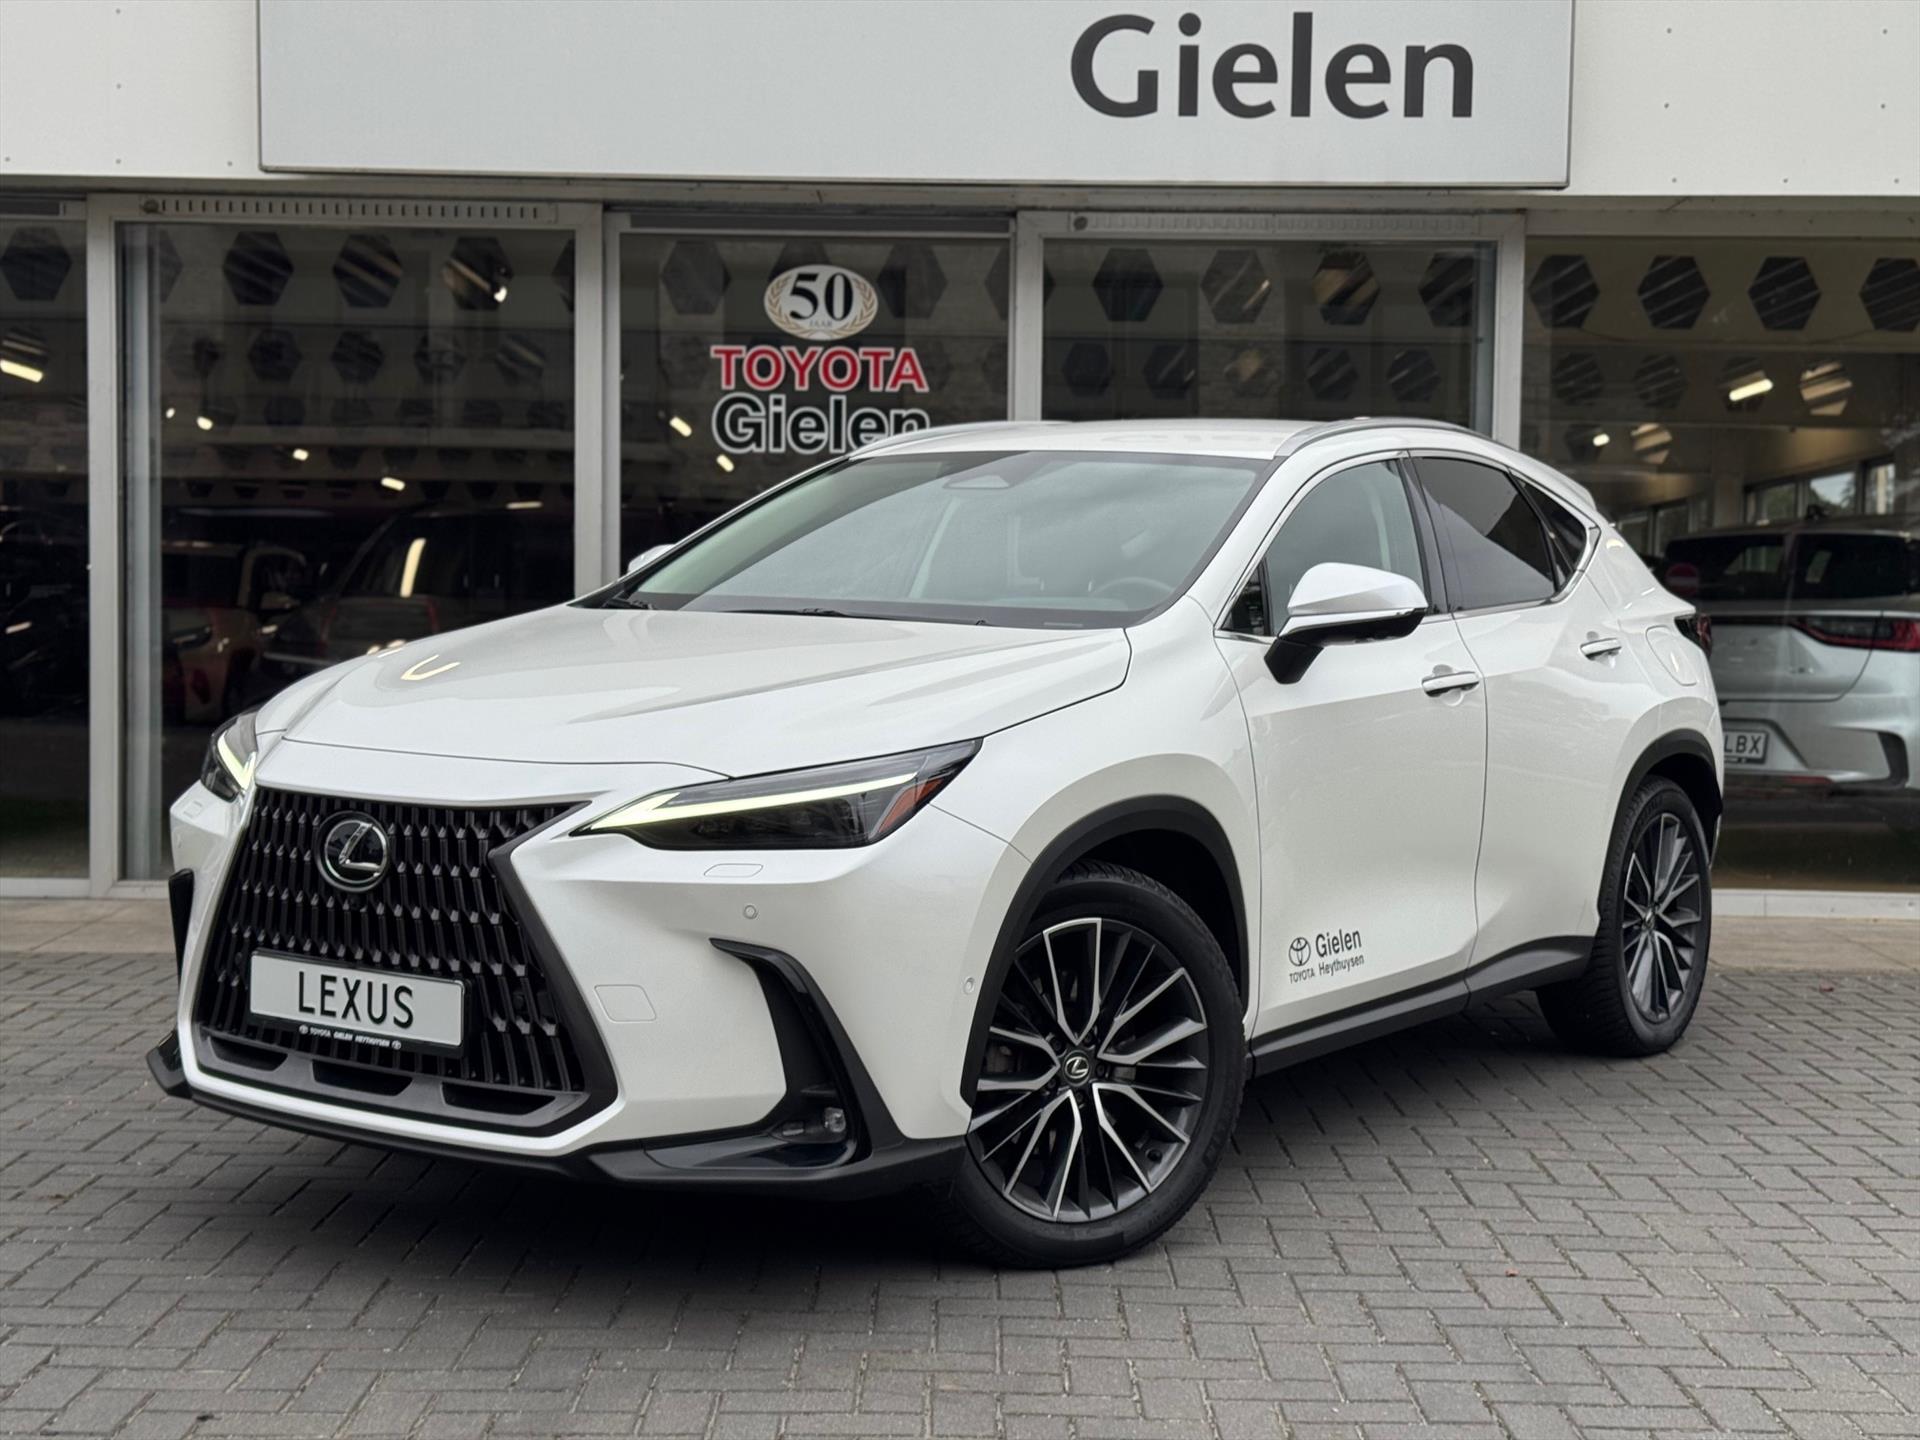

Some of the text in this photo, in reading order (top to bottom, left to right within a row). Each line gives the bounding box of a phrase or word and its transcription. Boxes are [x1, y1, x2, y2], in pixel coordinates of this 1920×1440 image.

[1070, 12, 1474, 119] Gielen
[790, 272, 854, 321] 50
[711, 345, 930, 392] TOYOTA
[1724, 735, 1762, 754] LBX
[1315, 928, 1362, 958] Gielen
[1289, 954, 1365, 984] TOYOTA Heythuysen
[298, 970, 415, 1029] LEXUS
[309, 1027, 331, 1038] TOYOTA
